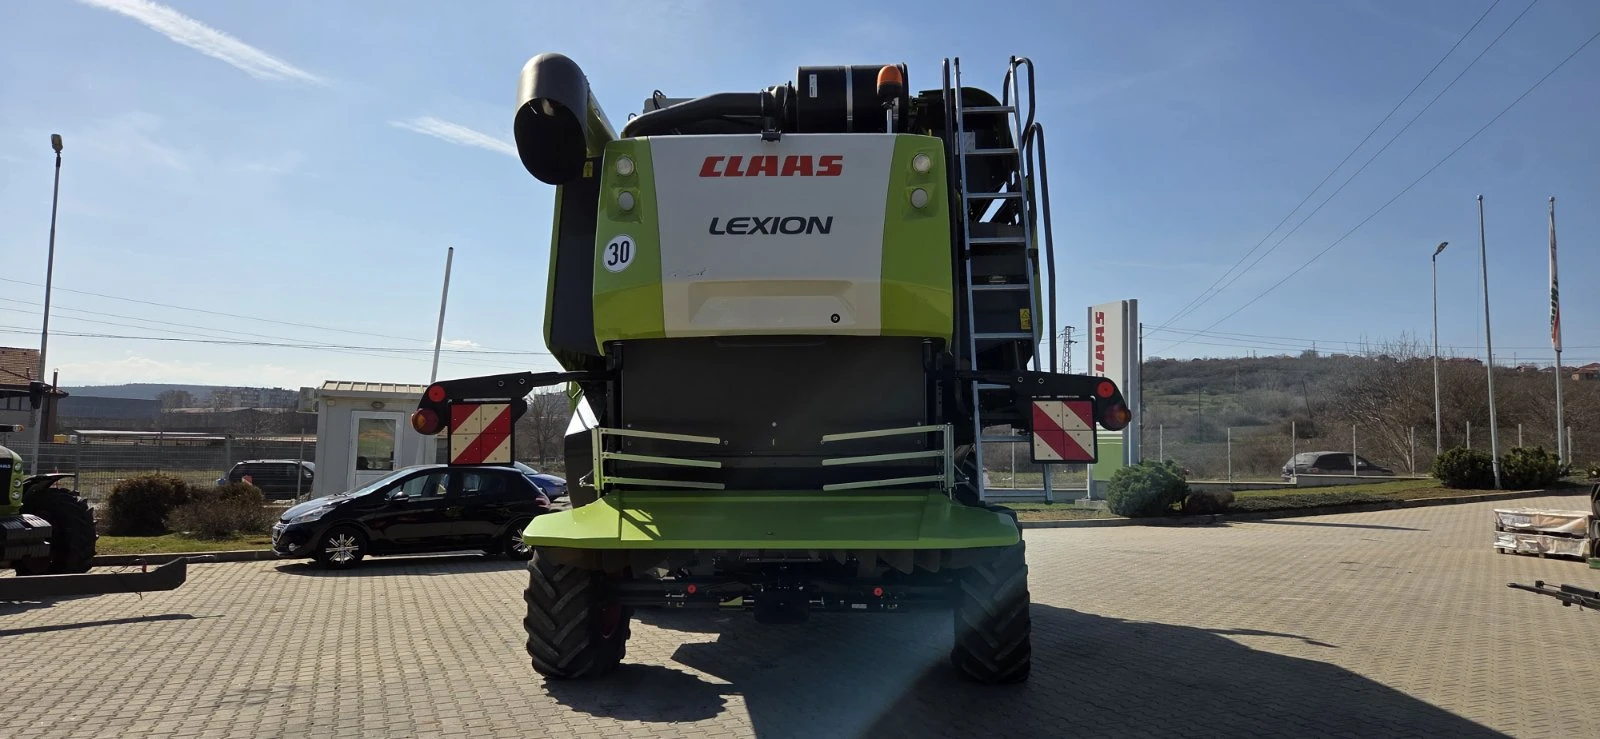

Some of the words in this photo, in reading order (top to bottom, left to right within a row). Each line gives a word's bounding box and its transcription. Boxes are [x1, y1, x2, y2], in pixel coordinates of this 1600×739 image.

[699, 155, 844, 177] CLAAS
[708, 216, 834, 235] LEXION
[608, 240, 630, 266] 30
[1095, 311, 1105, 377] LAAS
